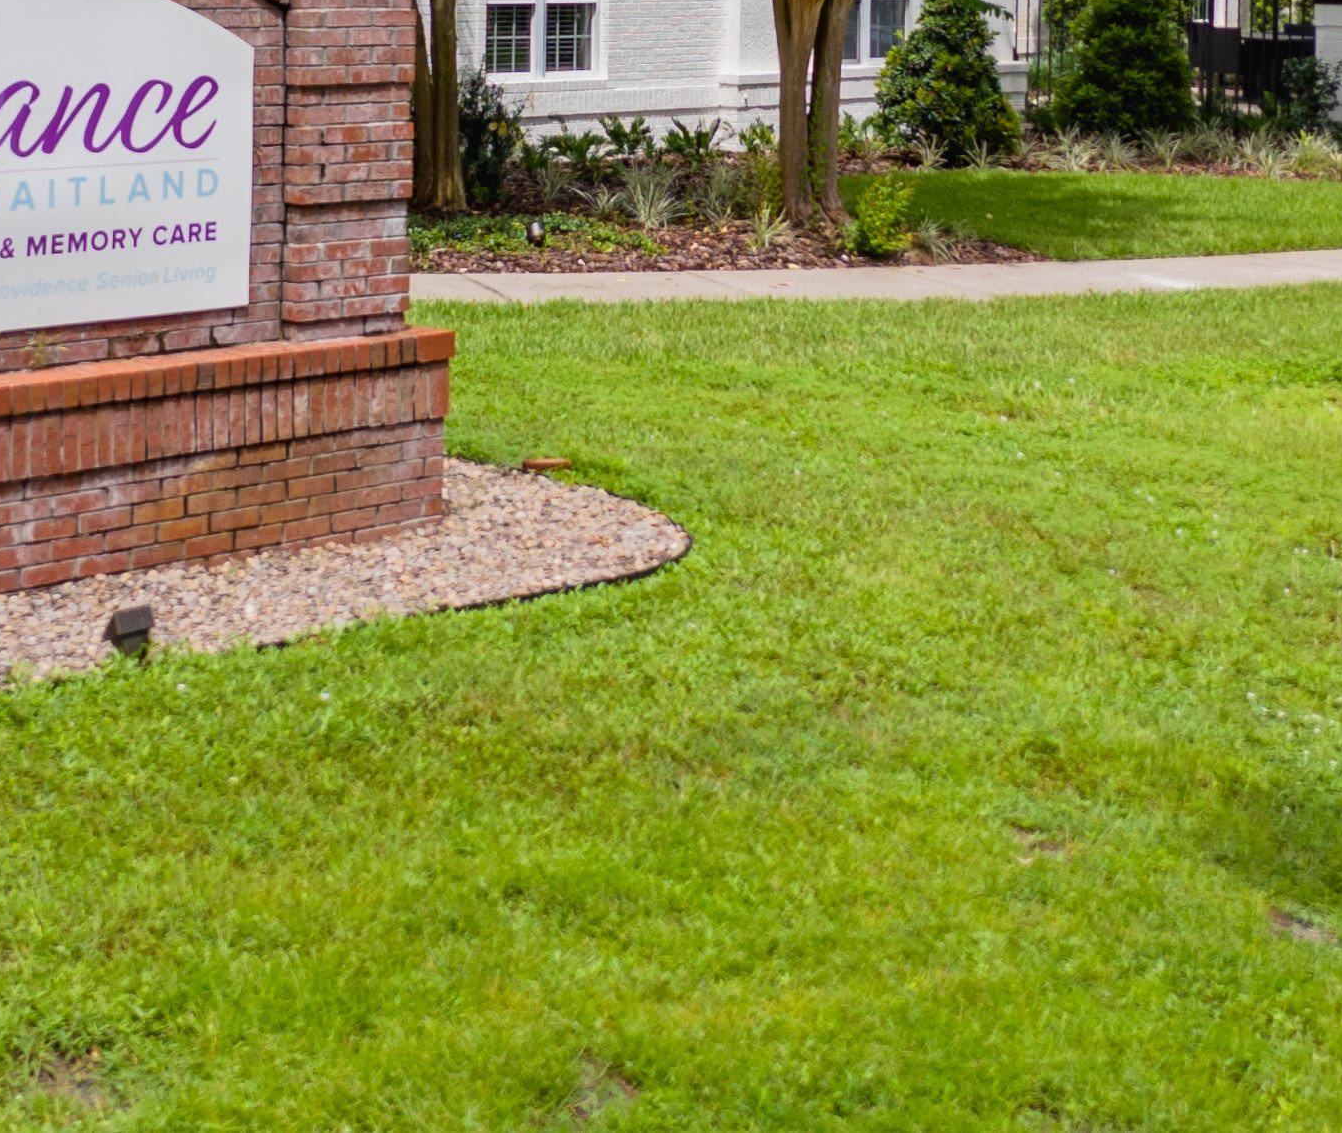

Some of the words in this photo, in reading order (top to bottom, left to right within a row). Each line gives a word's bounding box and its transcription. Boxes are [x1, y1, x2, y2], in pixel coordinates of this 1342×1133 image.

[0, 237, 15, 259] &
[27, 227, 143, 257] MEMORY
[152, 221, 219, 246] CARE
[96, 270, 158, 291] Senior
[162, 264, 218, 284] Living
